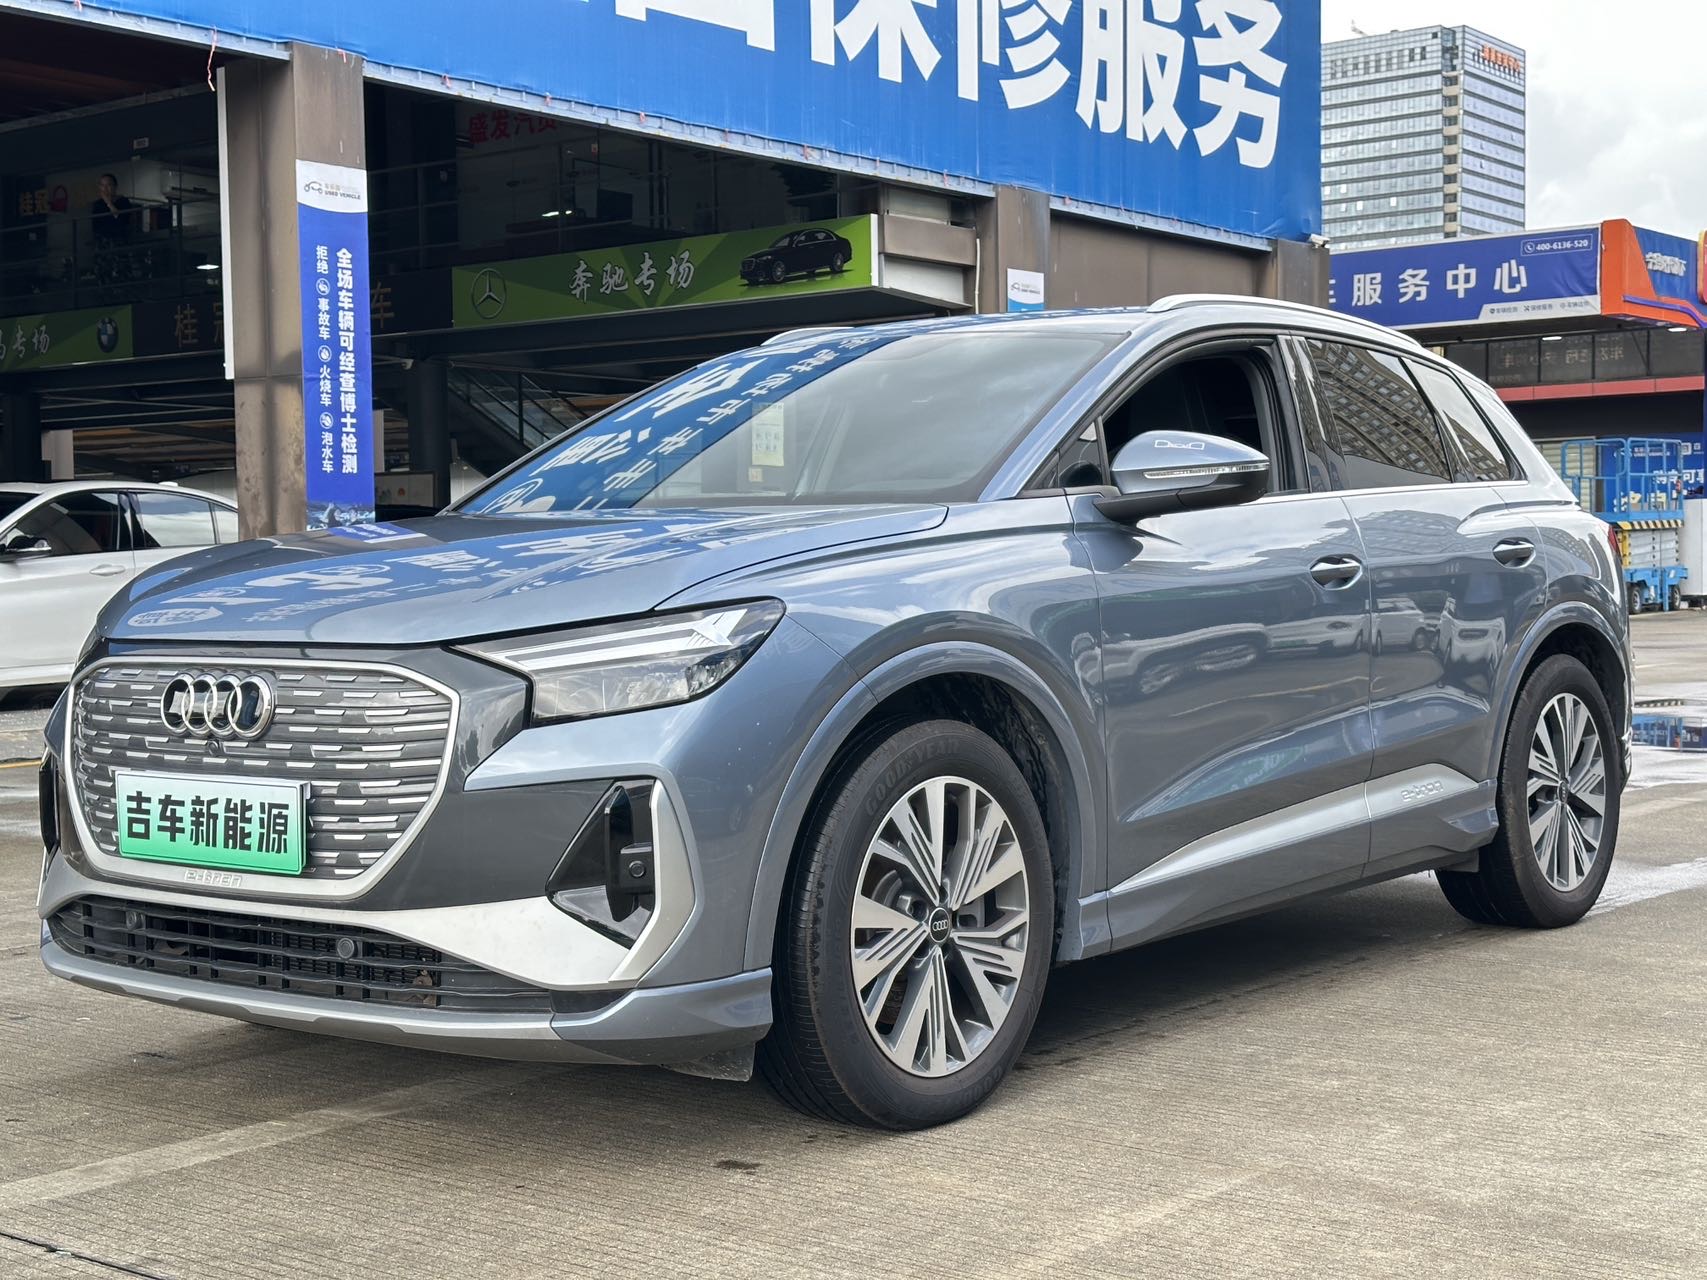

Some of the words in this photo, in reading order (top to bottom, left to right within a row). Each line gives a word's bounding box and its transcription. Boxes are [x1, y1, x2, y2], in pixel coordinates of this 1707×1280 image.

[316, 245, 329, 274] 拒绝
[1534, 239, 1589, 252] 400-6136-520
[569, 250, 695, 304] 奔驰专场
[318, 298, 331, 340] 事故车
[336, 248, 358, 474] 全场车辆可经查博士检测
[319, 365, 332, 407] 火烧车
[321, 432, 334, 473] 泡水车
[126, 790, 290, 855] 吉车新能源
